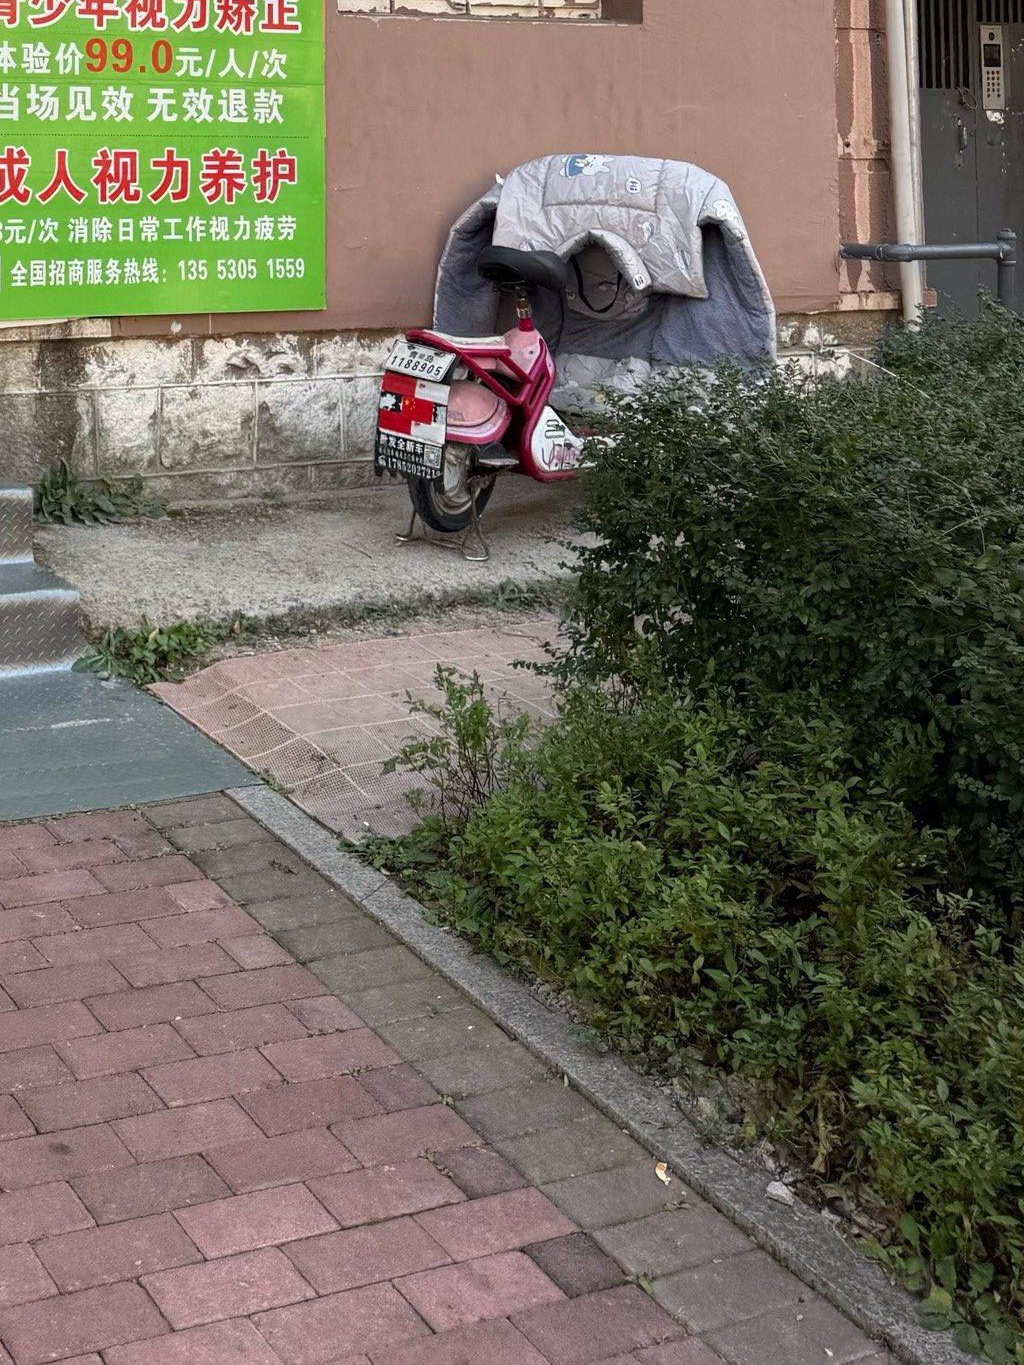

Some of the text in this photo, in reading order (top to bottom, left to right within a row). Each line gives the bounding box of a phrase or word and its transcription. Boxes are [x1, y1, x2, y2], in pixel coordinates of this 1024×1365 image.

[146, 88, 284, 124] 无效退款
[68, 215, 298, 243] 消除日常工作视力疲劳
[178, 260, 208, 281] 135
[217, 259, 257, 280] 5305
[266, 257, 305, 279] 1559
[391, 355, 443, 376] 1188905
